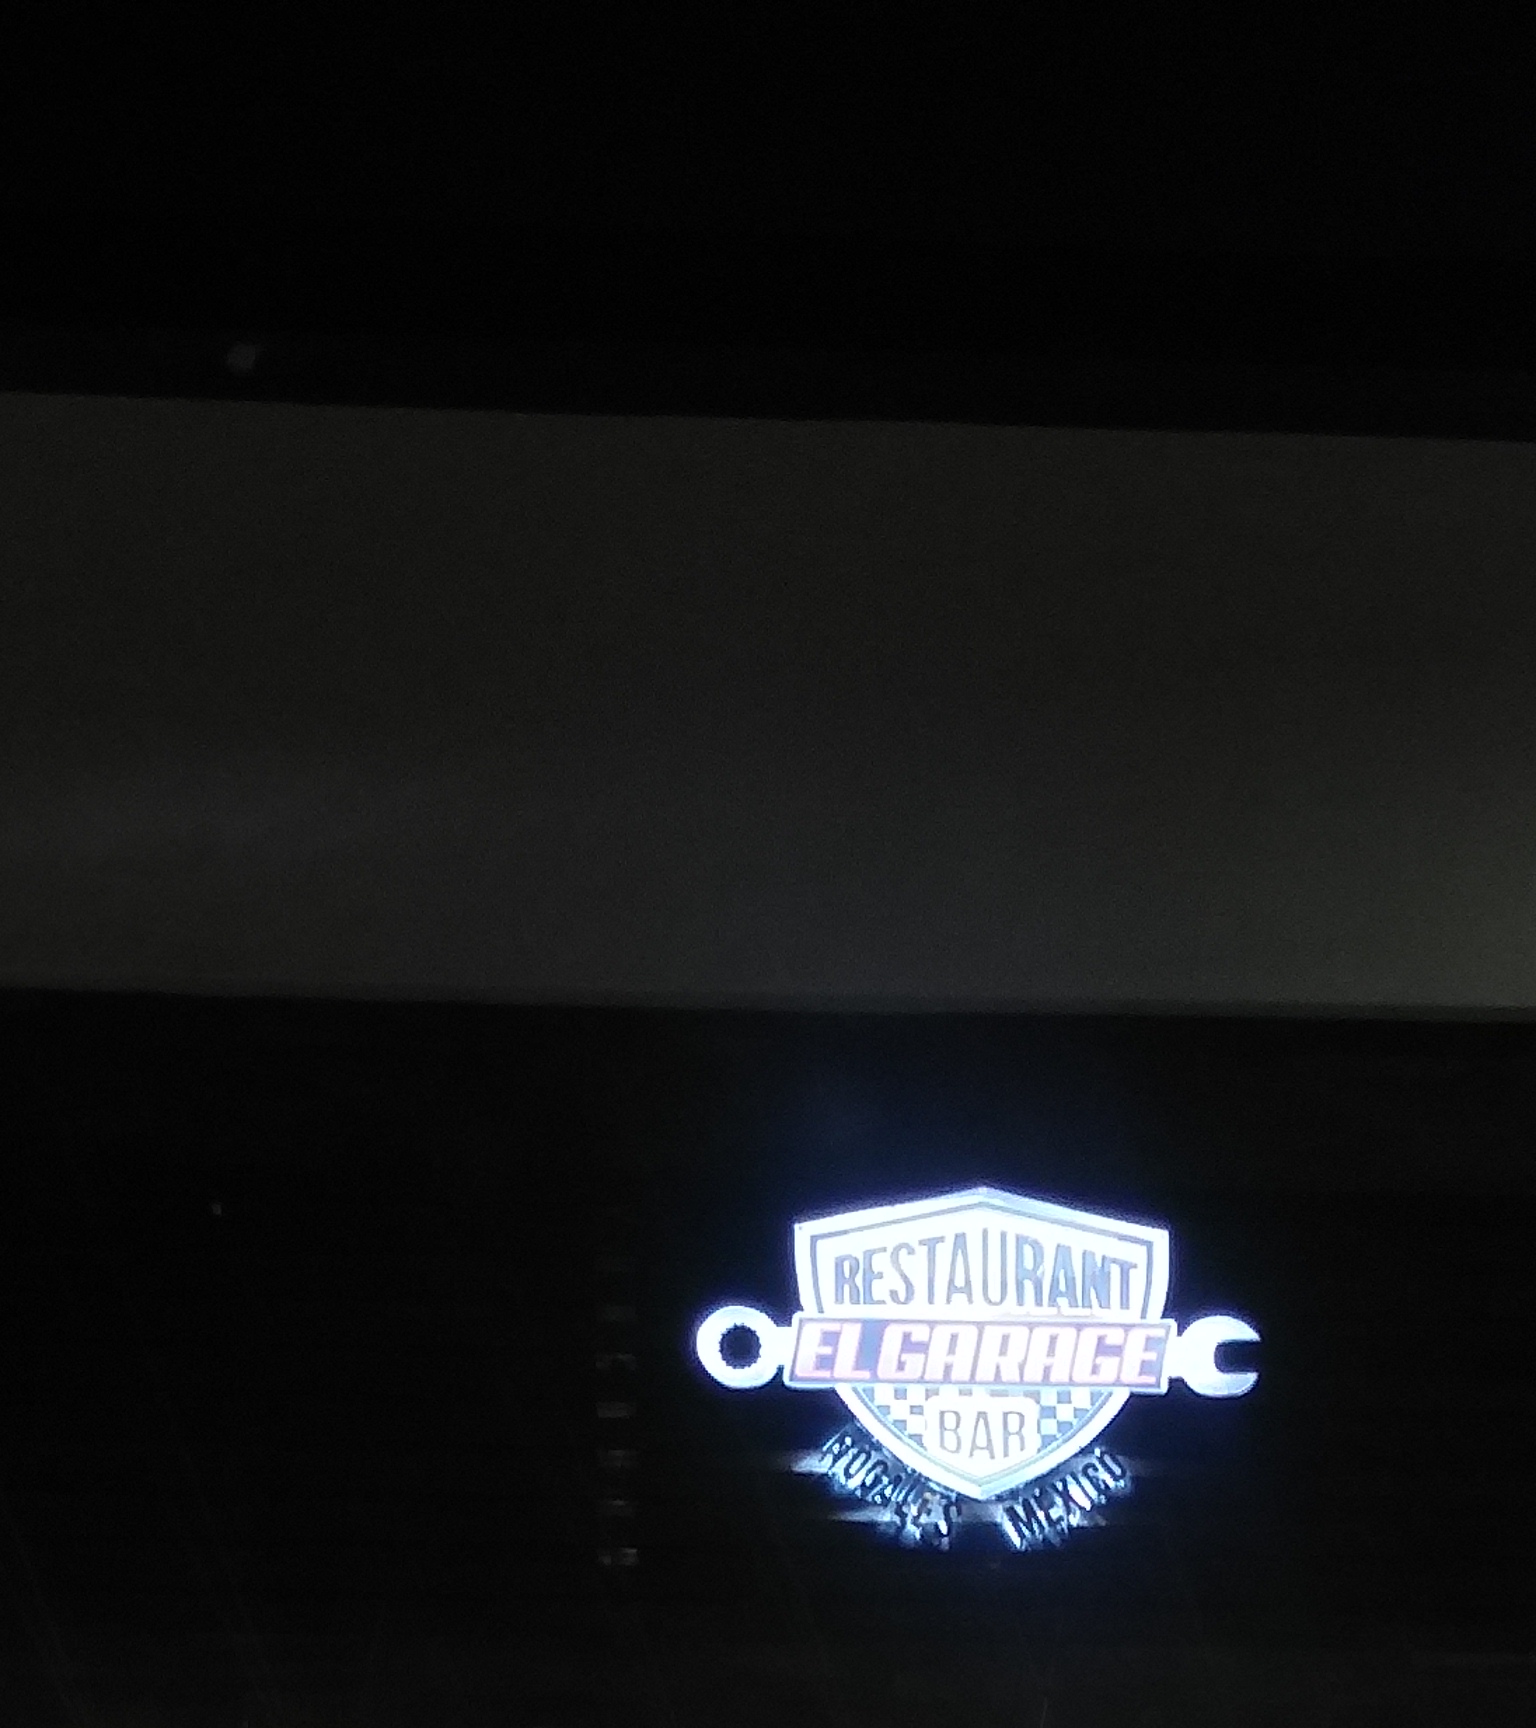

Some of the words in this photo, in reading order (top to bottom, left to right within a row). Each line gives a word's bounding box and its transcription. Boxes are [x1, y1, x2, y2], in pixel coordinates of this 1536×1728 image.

[834, 1229, 1137, 1310] RESTAURANT
[797, 1322, 873, 1379] EL
[879, 1325, 1162, 1384] GARAGE
[938, 1409, 1027, 1459] BAR
